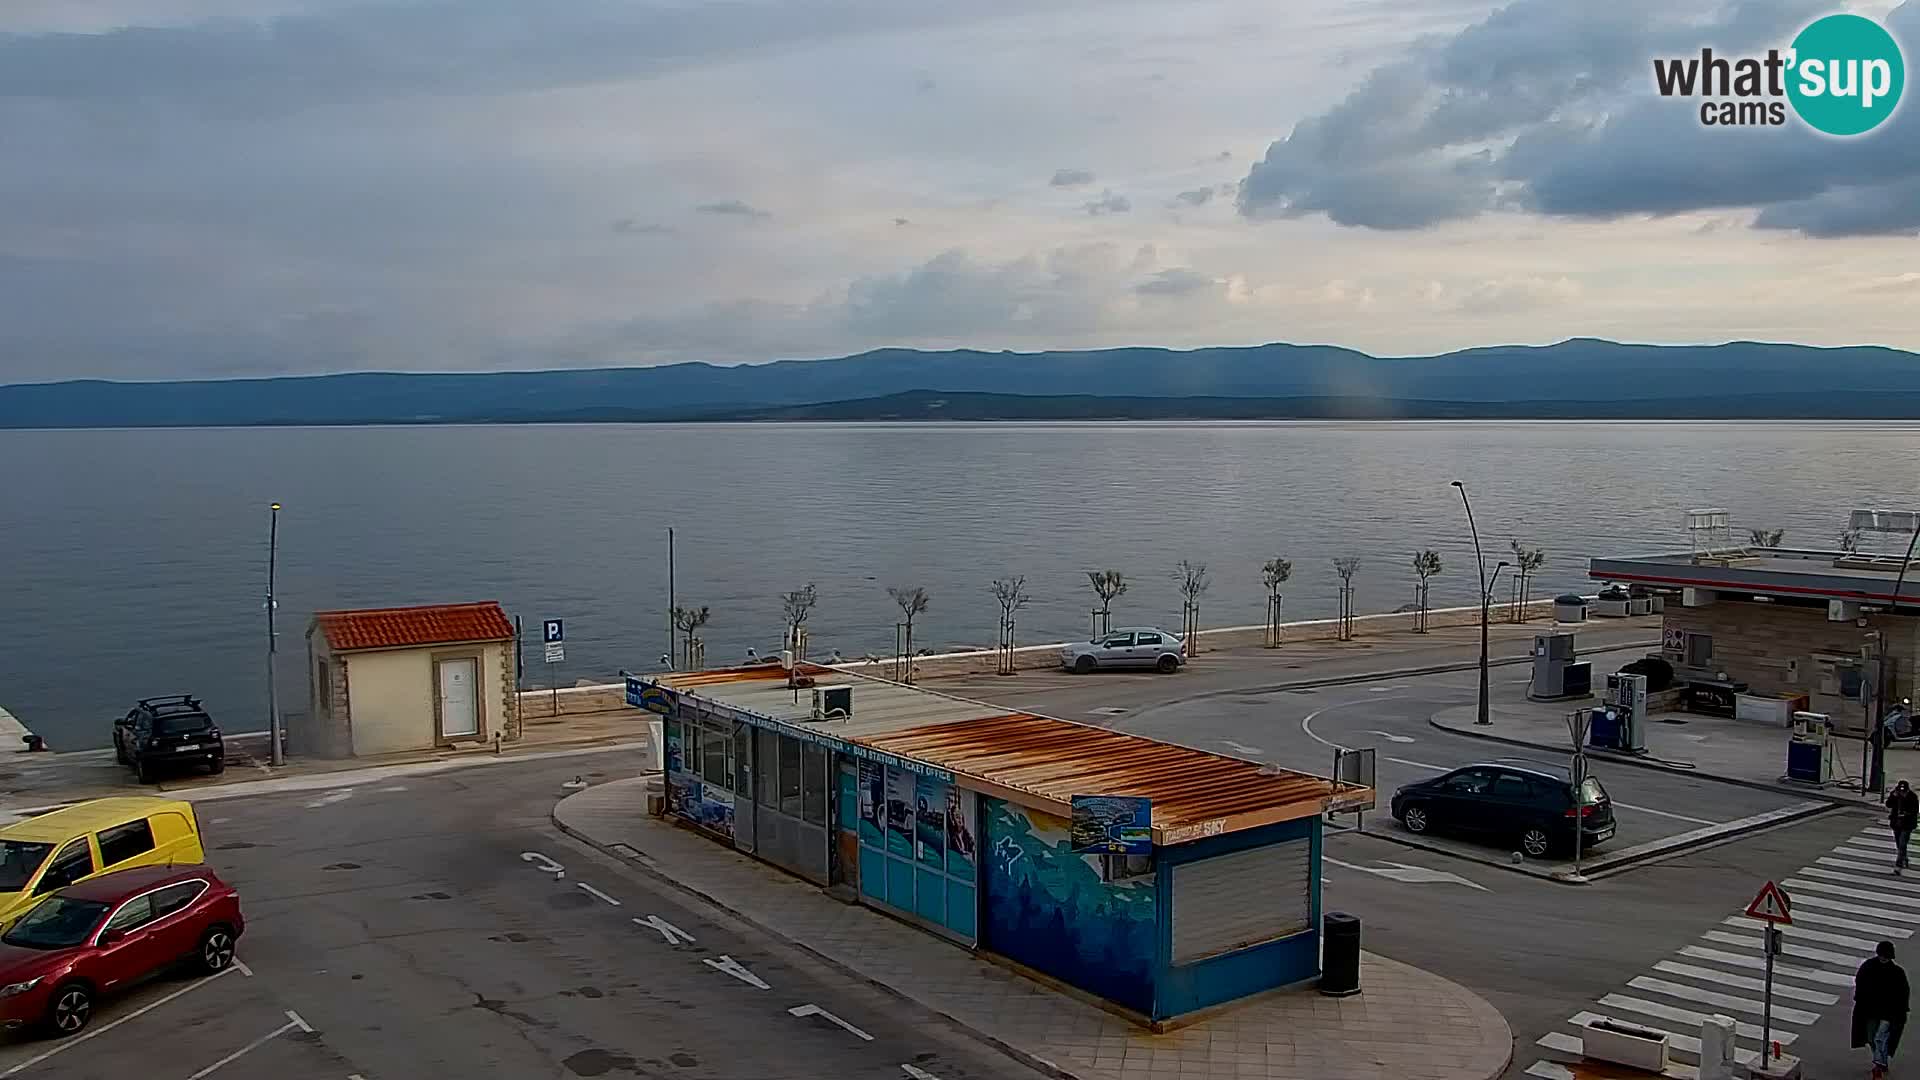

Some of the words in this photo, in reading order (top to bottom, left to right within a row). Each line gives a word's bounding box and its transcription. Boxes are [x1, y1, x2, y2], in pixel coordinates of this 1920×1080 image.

[548, 623, 559, 640] P
[853, 746, 867, 759] BUS
[868, 750, 898, 767] STATION
[900, 759, 925, 775] TICKET
[926, 765, 951, 782] OFFICE
